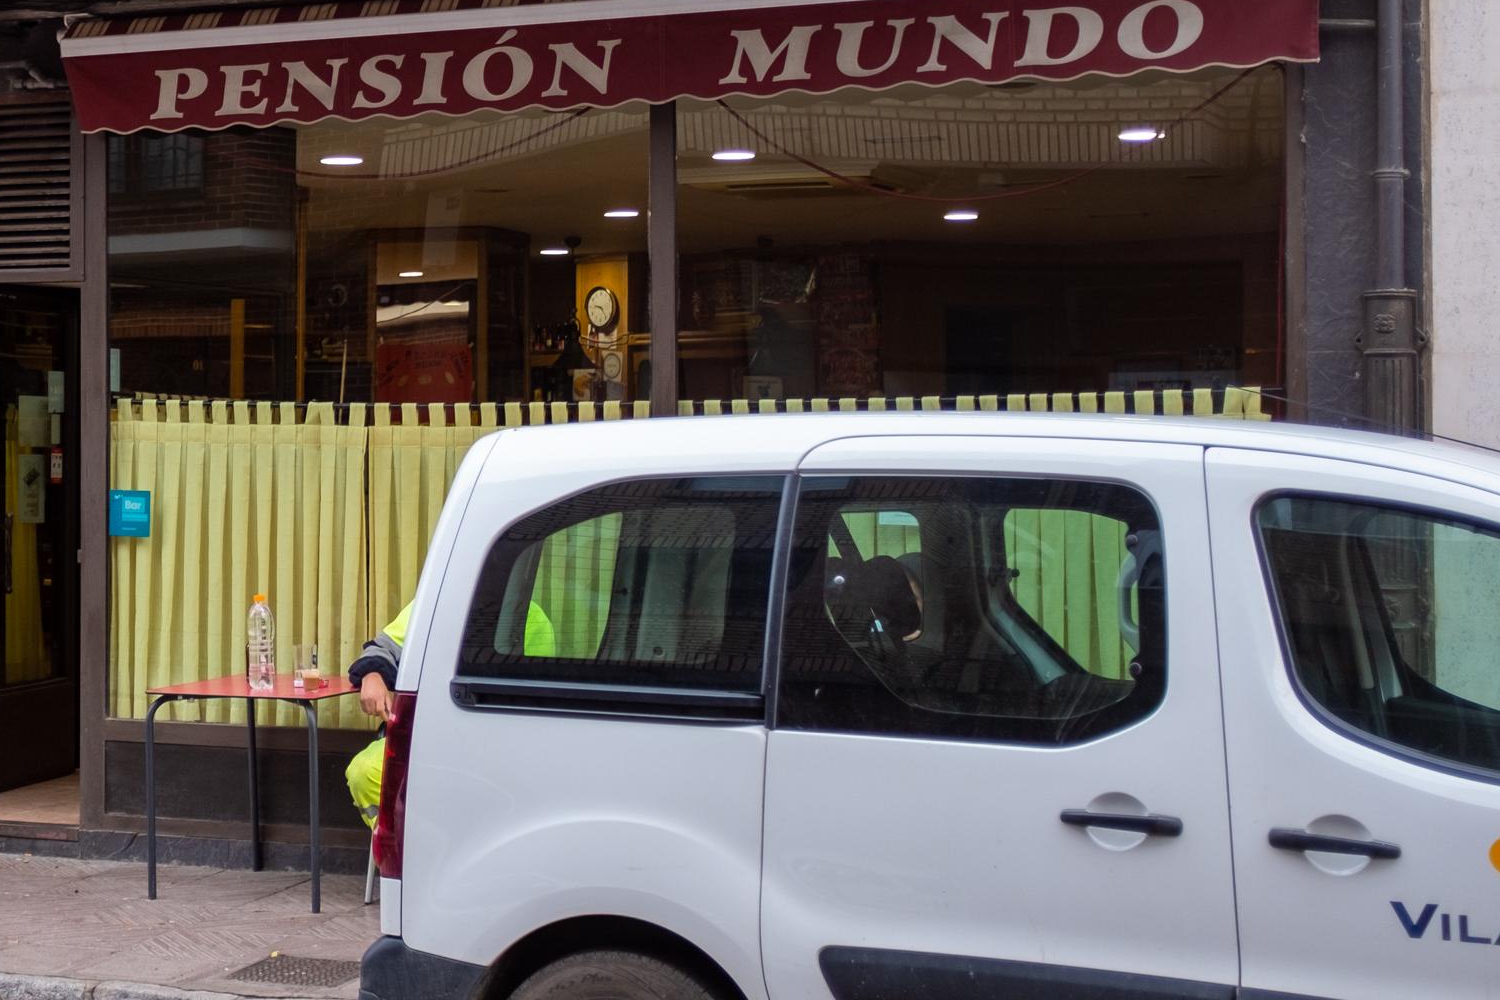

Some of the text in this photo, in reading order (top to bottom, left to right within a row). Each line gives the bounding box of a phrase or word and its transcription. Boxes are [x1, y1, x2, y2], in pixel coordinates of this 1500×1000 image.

[150, 29, 621, 120] PENSIÓN
[124, 500, 141, 510] Bar
[1389, 901, 1500, 945] VIL
